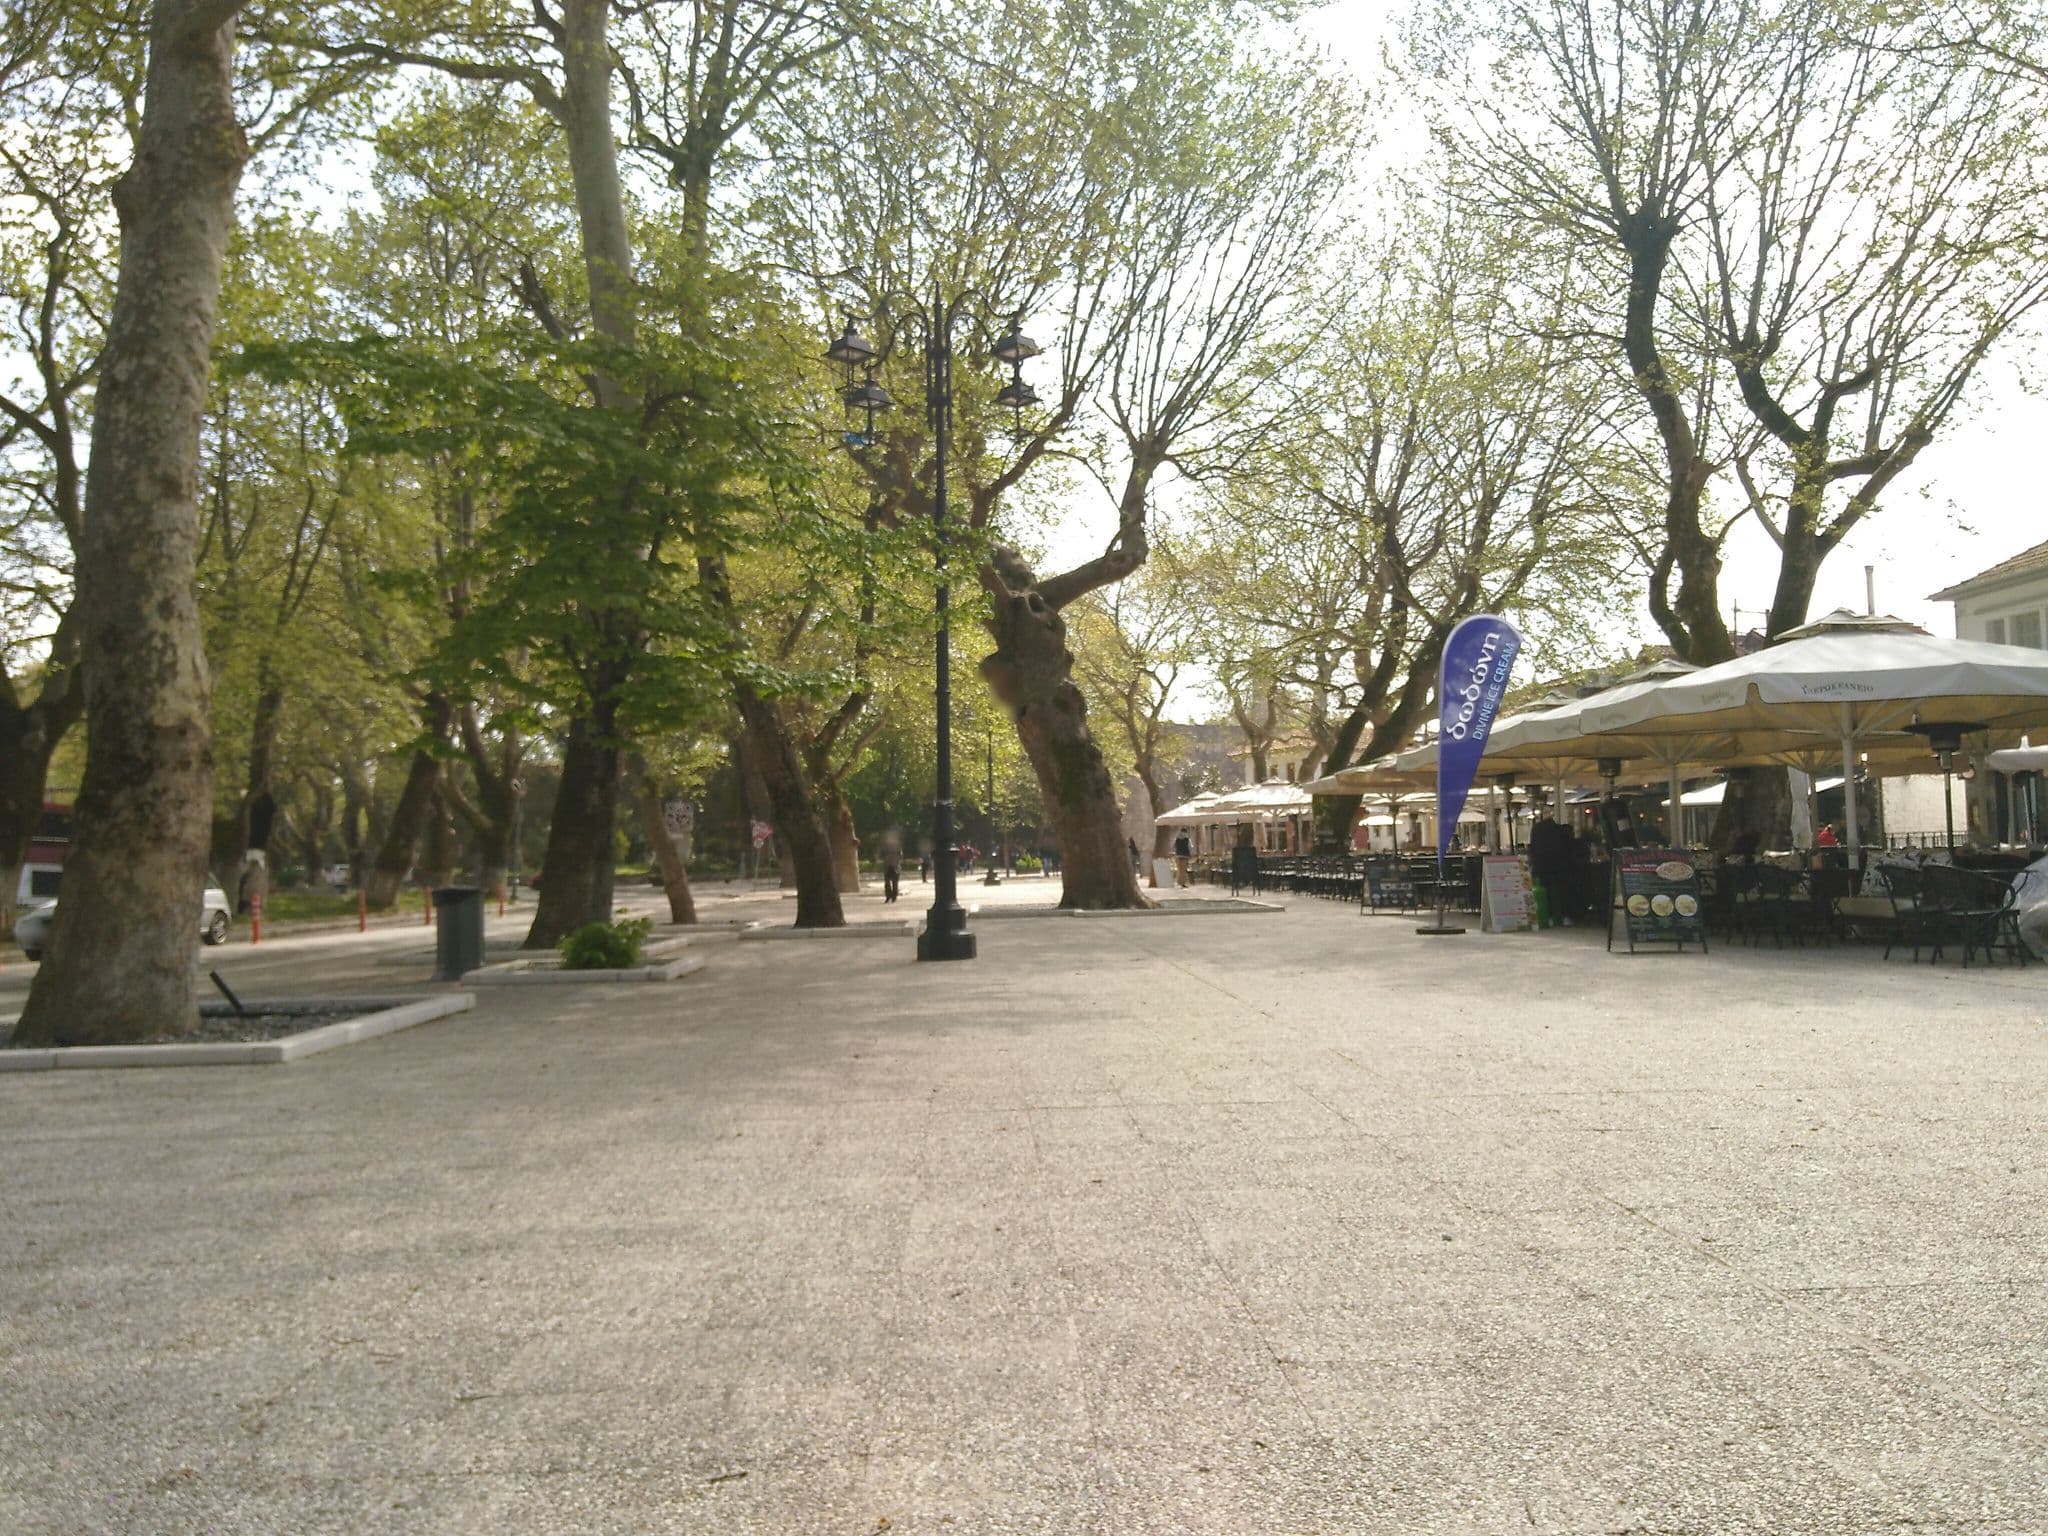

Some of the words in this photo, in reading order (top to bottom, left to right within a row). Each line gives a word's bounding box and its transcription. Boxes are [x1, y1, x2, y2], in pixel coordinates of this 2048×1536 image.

[1493, 641, 1515, 683] CREAM
[1487, 683, 1501, 703] ICE
[1472, 702, 1494, 741] DIVINE
